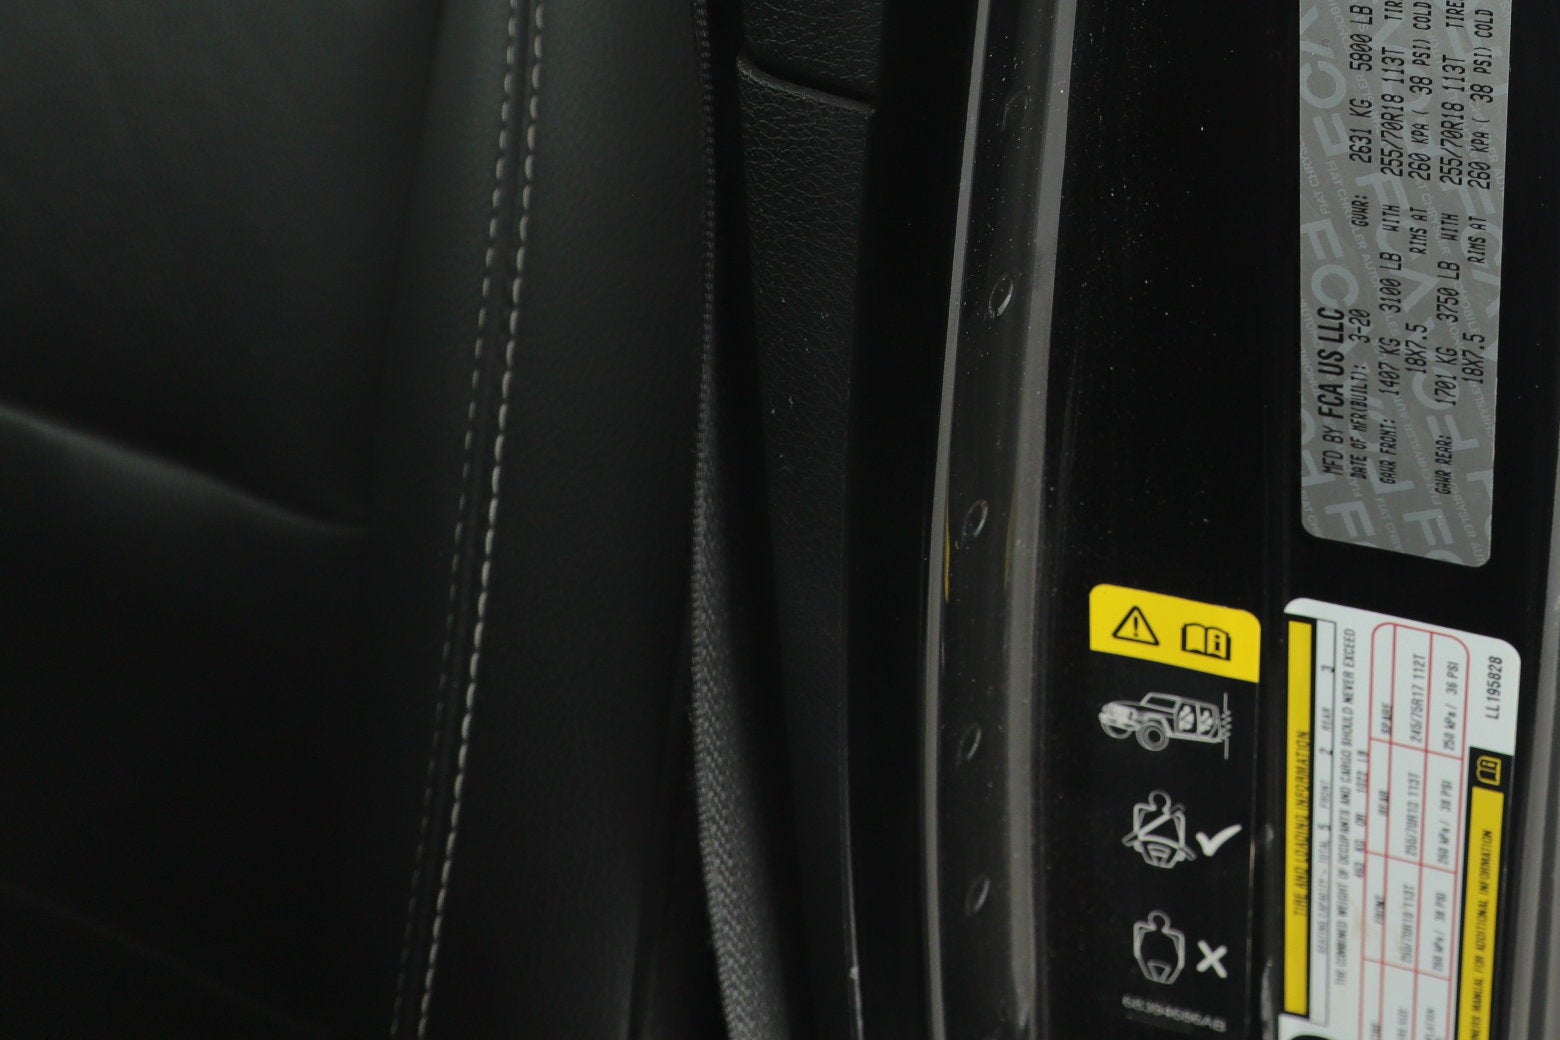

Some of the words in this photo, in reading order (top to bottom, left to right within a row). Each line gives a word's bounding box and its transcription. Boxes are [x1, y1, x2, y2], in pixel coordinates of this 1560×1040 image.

[1350, 5, 1373, 24] LB
[1413, 2, 1431, 30] COLD
[1474, 10, 1493, 38] COLD
[1350, 34, 1373, 72] 5800
[1382, 47, 1404, 84] 113T
[1412, 39, 1431, 66] PSI)
[1473, 47, 1492, 74] PSI)
[1409, 76, 1432, 95] 38
[1443, 54, 1465, 92] 113T
[1470, 84, 1493, 104] 38
[1350, 99, 1372, 118] KG
[1350, 128, 1372, 163] 2631
[1382, 95, 1404, 176] 255/70R18
[1411, 124, 1429, 144] KPA
[1441, 102, 1464, 185] 255/70R18
[1471, 132, 1489, 153] KPA
[1408, 154, 1431, 181] 260
[1469, 162, 1490, 189] 260
[1352, 195, 1368, 227] GVWR:
[1383, 205, 1399, 231] WITH
[1410, 207, 1427, 221] AT
[1470, 216, 1486, 231] AT
[1410, 228, 1427, 254] RIMS
[1441, 214, 1458, 241] WITH
[1380, 252, 1401, 270] LB
[1468, 237, 1485, 263] RIMS
[1438, 261, 1459, 279] LB
[1380, 279, 1401, 313] 3100
[1437, 288, 1458, 322] 3750
[1317, 308, 1343, 344] LLC
[1349, 309, 1370, 343] 3-20
[1380, 337, 1399, 356] KG
[1406, 324, 1427, 374] 18X7.5
[1436, 348, 1456, 365] KG
[1463, 333, 1484, 384] 18X7.5
[1318, 349, 1343, 376] US
[1379, 362, 1399, 395] 1407
[1436, 374, 1456, 406] 1701
[1318, 384, 1343, 419] FCA
[1349, 365, 1368, 431] MFR(BUILT):
[1324, 425, 1342, 444] BY
[1351, 438, 1367, 449] OF
[1380, 418, 1396, 455] FRONT:
[1323, 451, 1343, 475] MFD
[1436, 434, 1452, 465] REAR:
[1350, 455, 1367, 479] DATE
[1380, 459, 1396, 484] GAWR
[1435, 470, 1451, 494] GAWR
[1343, 629, 1355, 668] EXCEED
[1411, 654, 1426, 679] 112T
[1446, 661, 1459, 679] PSI
[1343, 671, 1354, 704] NEVER
[1485, 656, 1502, 719] LL195828
[1409, 684, 1424, 743] 245/75R17
[1342, 708, 1353, 747] SHOULD
[1295, 730, 1311, 811] INFORMATION
[1340, 750, 1352, 783] CARGO
[1340, 787, 1351, 805] AND
[1294, 815, 1310, 863] LOADING
[1337, 810, 1349, 865] OCCUPANTS
[1294, 867, 1309, 889] AND
[1337, 869, 1348, 880] OF
[1293, 894, 1308, 917] TIRE
[1335, 883, 1347, 918] WEIGHT
[1335, 922, 1347, 967] COMBINED
[1467, 1016, 1481, 1040] NERS
[1477, 829, 1493, 895] INFORMATION
[1334, 971, 1346, 986] THE
